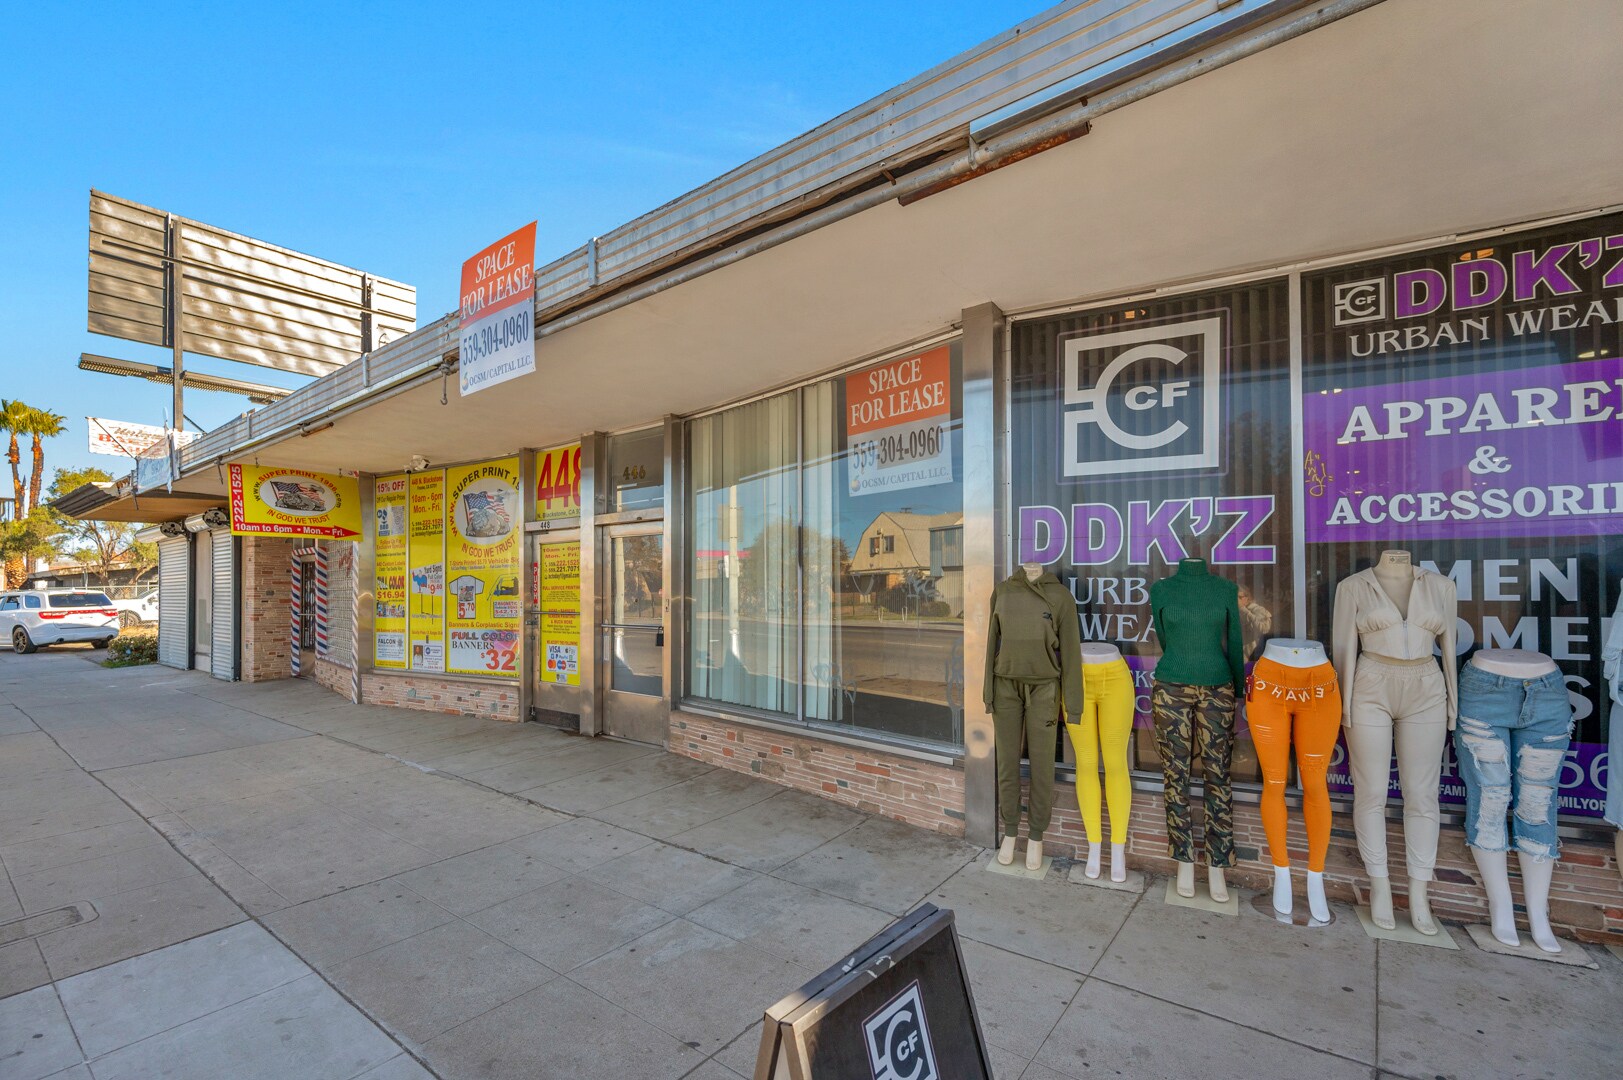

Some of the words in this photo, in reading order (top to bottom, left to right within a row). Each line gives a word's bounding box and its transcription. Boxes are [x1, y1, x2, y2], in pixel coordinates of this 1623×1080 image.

[476, 241, 516, 283] SPACE
[462, 285, 485, 320] FOR
[487, 264, 531, 306] LEASE
[463, 311, 528, 365] 559-304-0960
[1350, 316, 1490, 357] URBAN
[469, 360, 516, 386] OCSM/CAPITAL
[868, 358, 922, 395] SPACE
[851, 398, 885, 426] FOR
[888, 381, 945, 418] LEASE
[1337, 378, 1623, 444] APPARE
[853, 426, 944, 469] 559-304-0960
[1468, 445, 1512, 474] &
[289, 468, 318, 480] PRINT
[377, 482, 390, 493] 15%
[392, 480, 405, 491] OFF
[482, 467, 510, 479] PRINT
[862, 470, 928, 489] OCSM/CAPITAL
[232, 466, 244, 523] 222-1525
[414, 505, 427, 513] Mon.
[432, 503, 441, 511] Fri.
[431, 493, 443, 502] 6pm
[1326, 481, 1623, 525] ACCESSORI
[234, 522, 260, 532] 10am
[262, 524, 272, 532] to
[273, 524, 292, 534] 6pm
[303, 526, 324, 534] Mon.
[332, 528, 346, 536] Fri.
[267, 508, 276, 518] IN
[276, 512, 294, 523] GOD
[294, 517, 307, 525] WE
[307, 514, 330, 524] TRUST
[540, 521, 550, 530] 448
[1018, 494, 1276, 566] DDK'Z
[462, 543, 468, 554] IN
[469, 546, 482, 558] GOD
[484, 548, 494, 558] WE
[495, 535, 516, 554] TRUST
[377, 591, 405, 599] $16.94
[1068, 577, 1151, 606] URB
[452, 632, 479, 640] FULL
[1078, 613, 1156, 642] WEA
[452, 641, 494, 650] BANNERS
